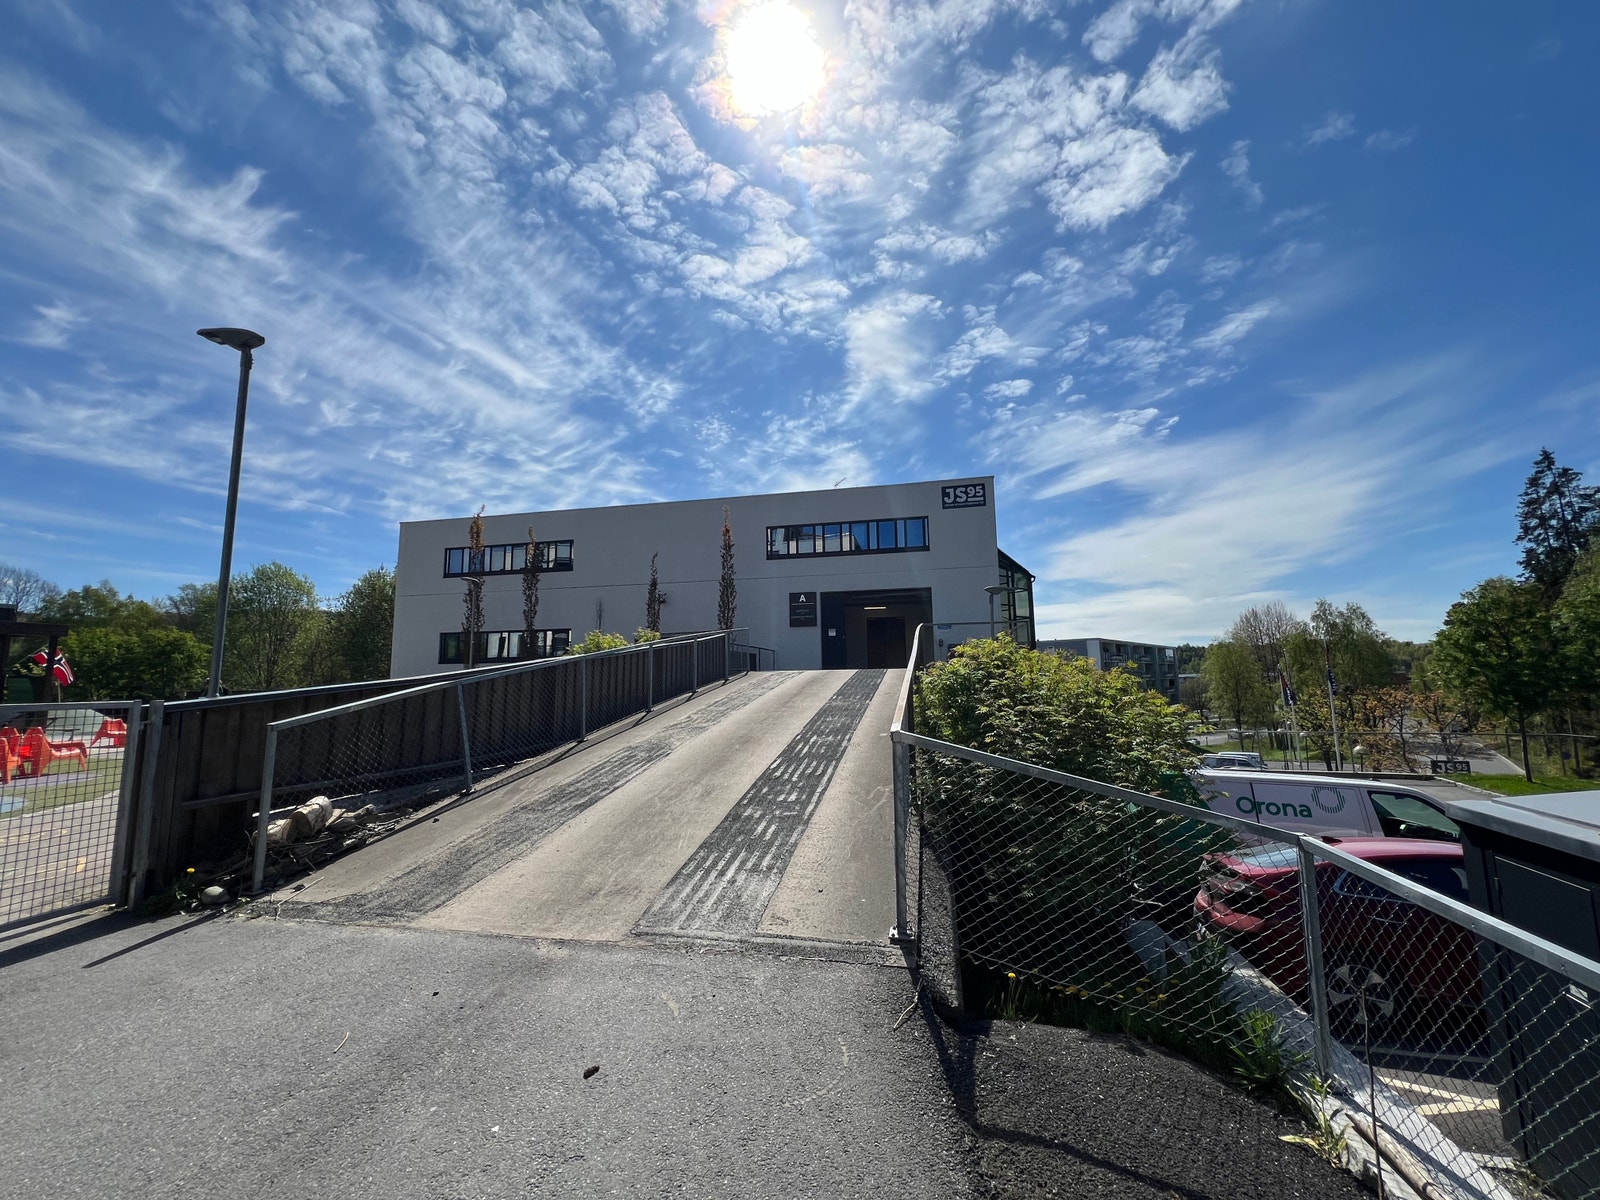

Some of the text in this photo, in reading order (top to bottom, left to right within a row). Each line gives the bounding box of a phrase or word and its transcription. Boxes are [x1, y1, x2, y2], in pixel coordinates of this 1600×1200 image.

[943, 486, 984, 503] JS95
[799, 594, 806, 602] A
[1436, 762, 1468, 773] JS95
[1235, 796, 1313, 818] Orona
